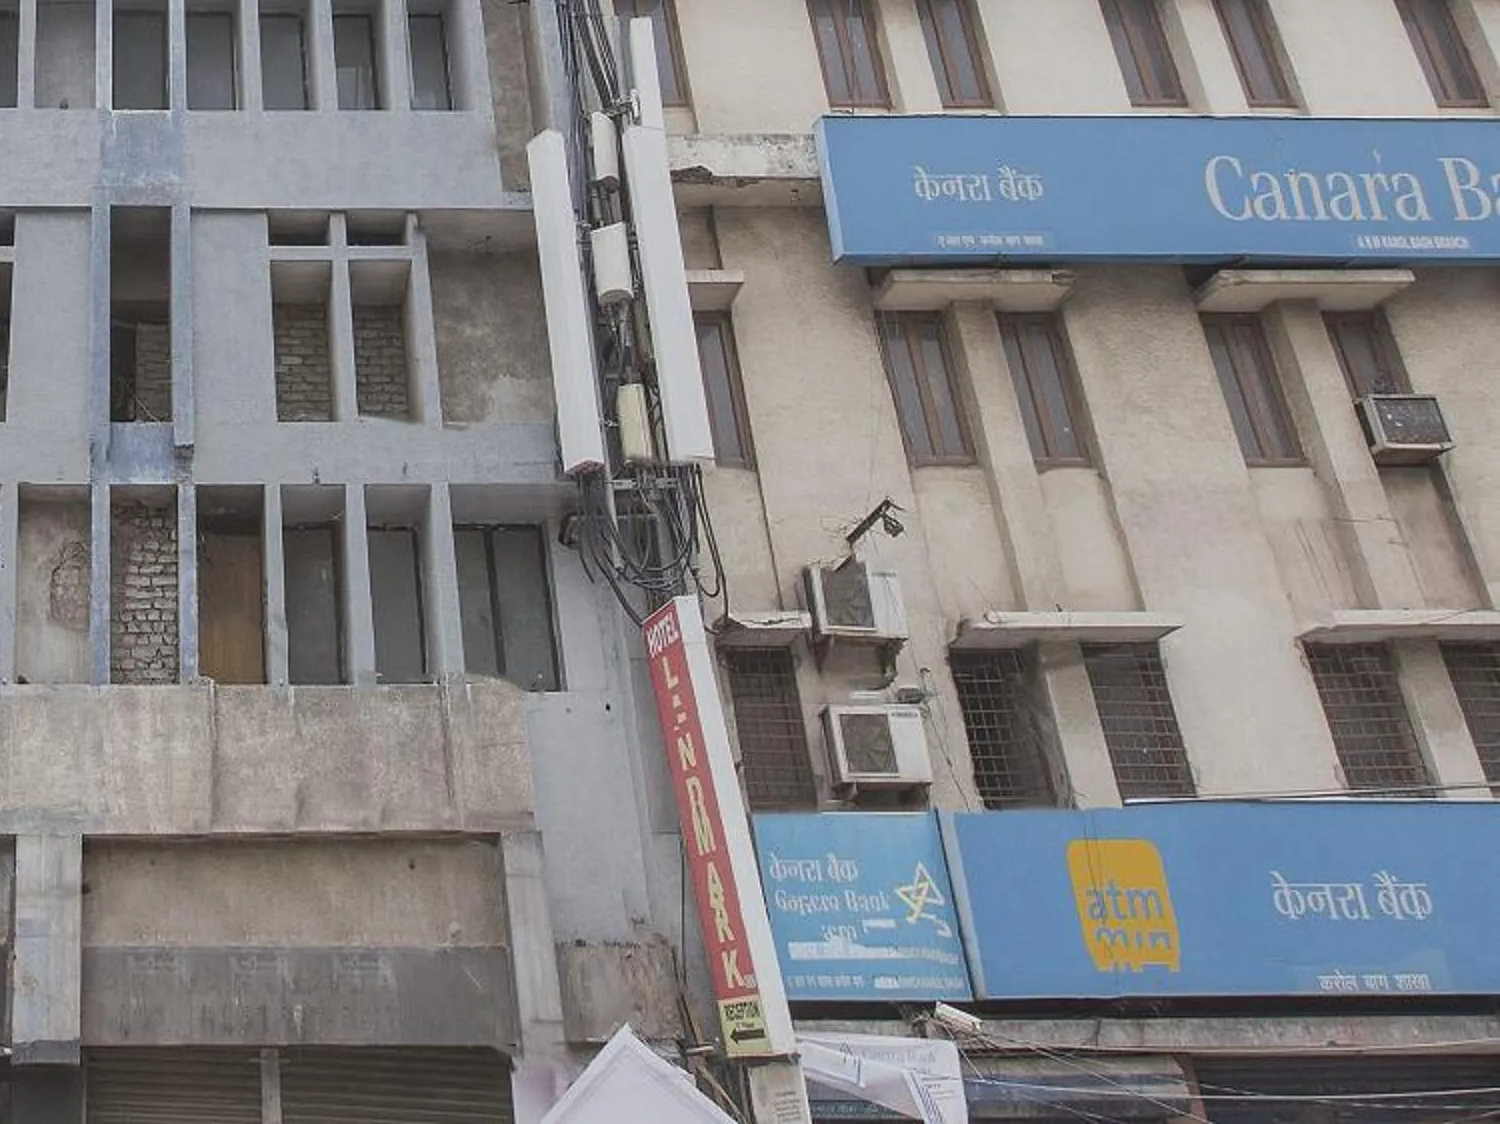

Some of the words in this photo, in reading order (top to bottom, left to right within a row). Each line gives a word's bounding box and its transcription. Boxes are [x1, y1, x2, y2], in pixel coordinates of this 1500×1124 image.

[914, 164, 993, 201] केनरा
[998, 163, 1045, 201] बैंक
[1204, 155, 1433, 222] Canara
[1085, 879, 1163, 921] atm
[1270, 870, 1372, 920] केनरा
[1373, 870, 1432, 920] बैंक
